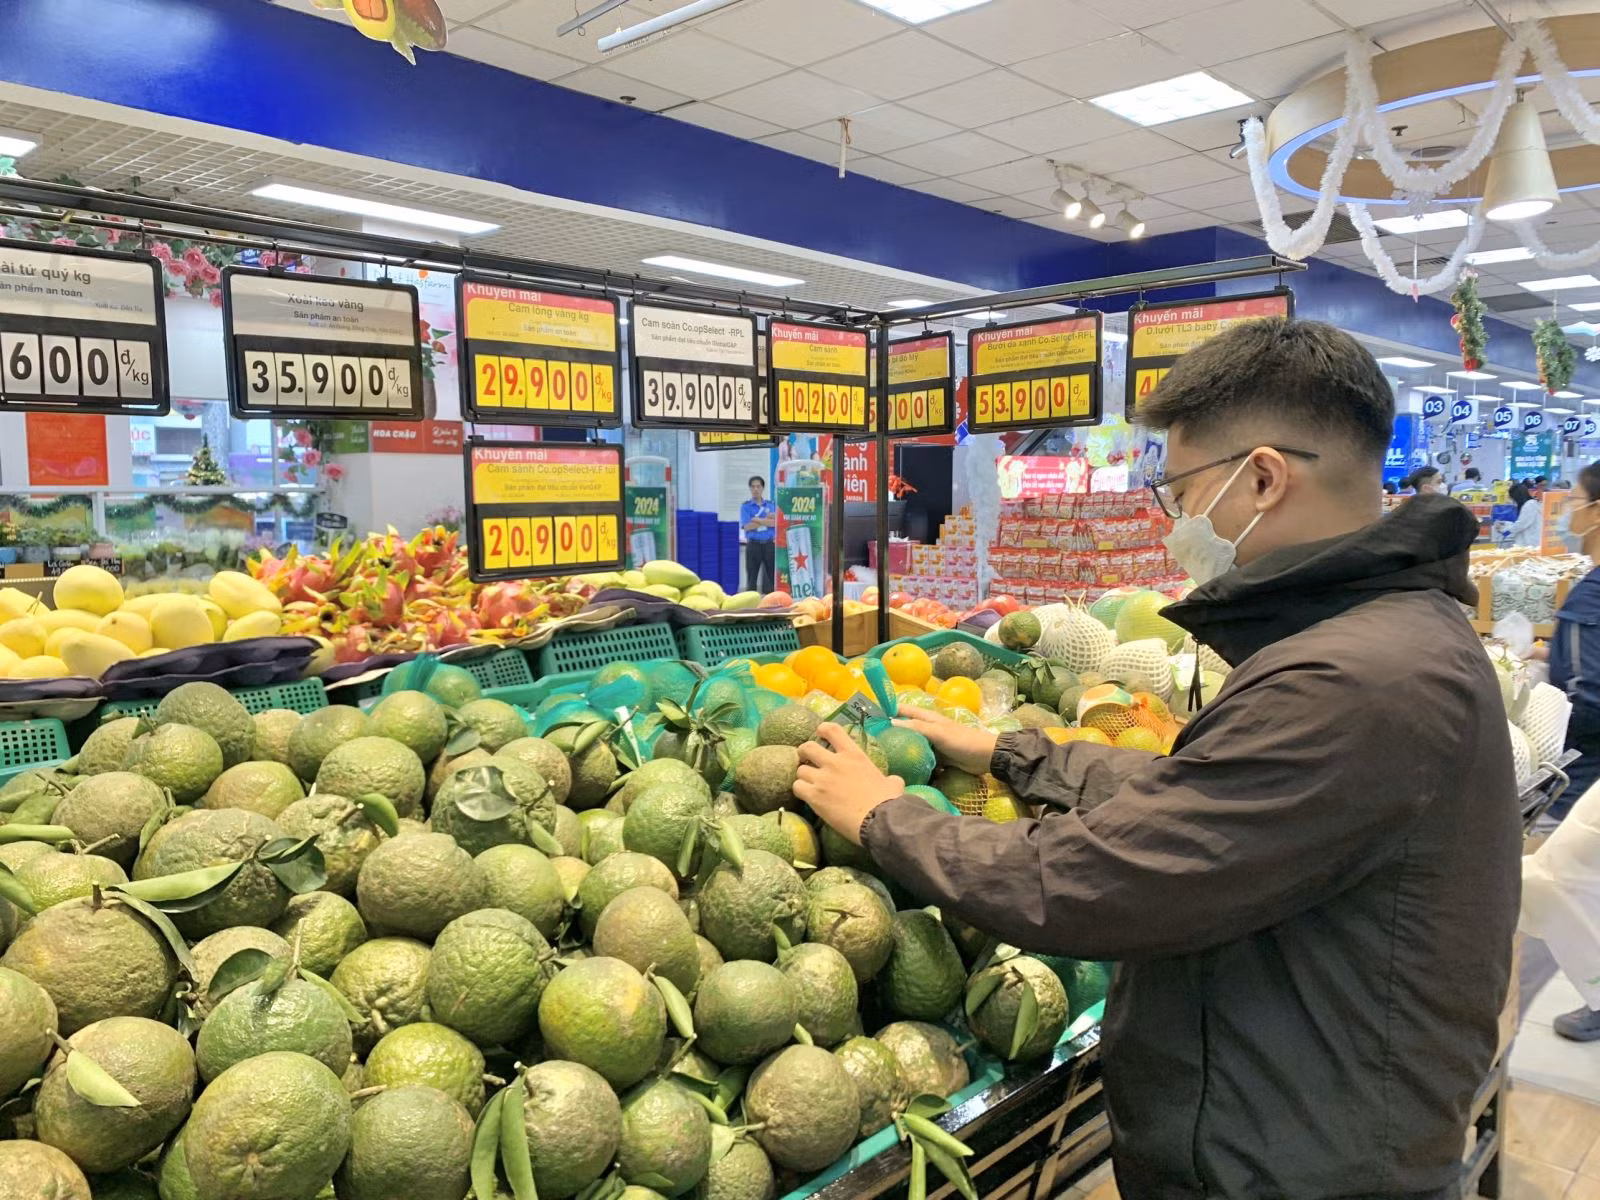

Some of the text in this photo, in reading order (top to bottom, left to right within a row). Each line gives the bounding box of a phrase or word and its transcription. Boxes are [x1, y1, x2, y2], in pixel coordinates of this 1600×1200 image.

[1, 261, 91, 284] ài tứ quý kg
[46, 287, 58, 295] an
[338, 297, 364, 312] vàng
[508, 303, 530, 314] Cam
[579, 311, 590, 322] kg
[1134, 308, 1203, 324] Khuyến mãi
[641, 317, 660, 329] Cam
[1194, 321, 1218, 333] baby
[772, 327, 803, 341] Khuyến
[10, 342, 109, 386] 600
[252, 360, 384, 396] 35.900
[482, 363, 588, 401] 29.900
[648, 378, 733, 411] 39.900
[979, 382, 1065, 416] 53.900
[784, 388, 850, 417] 10.200
[1425, 400, 1444, 413] 03
[1453, 404, 1471, 417] 04
[1495, 409, 1512, 423] 05
[1525, 414, 1541, 426] 06
[1565, 420, 1580, 431] 07
[131, 426, 151, 441] úc
[373, 430, 391, 438] HOA
[487, 464, 509, 474] Cam
[634, 496, 659, 516] 2024
[791, 496, 816, 513] 2024
[489, 522, 593, 557] 20.900
